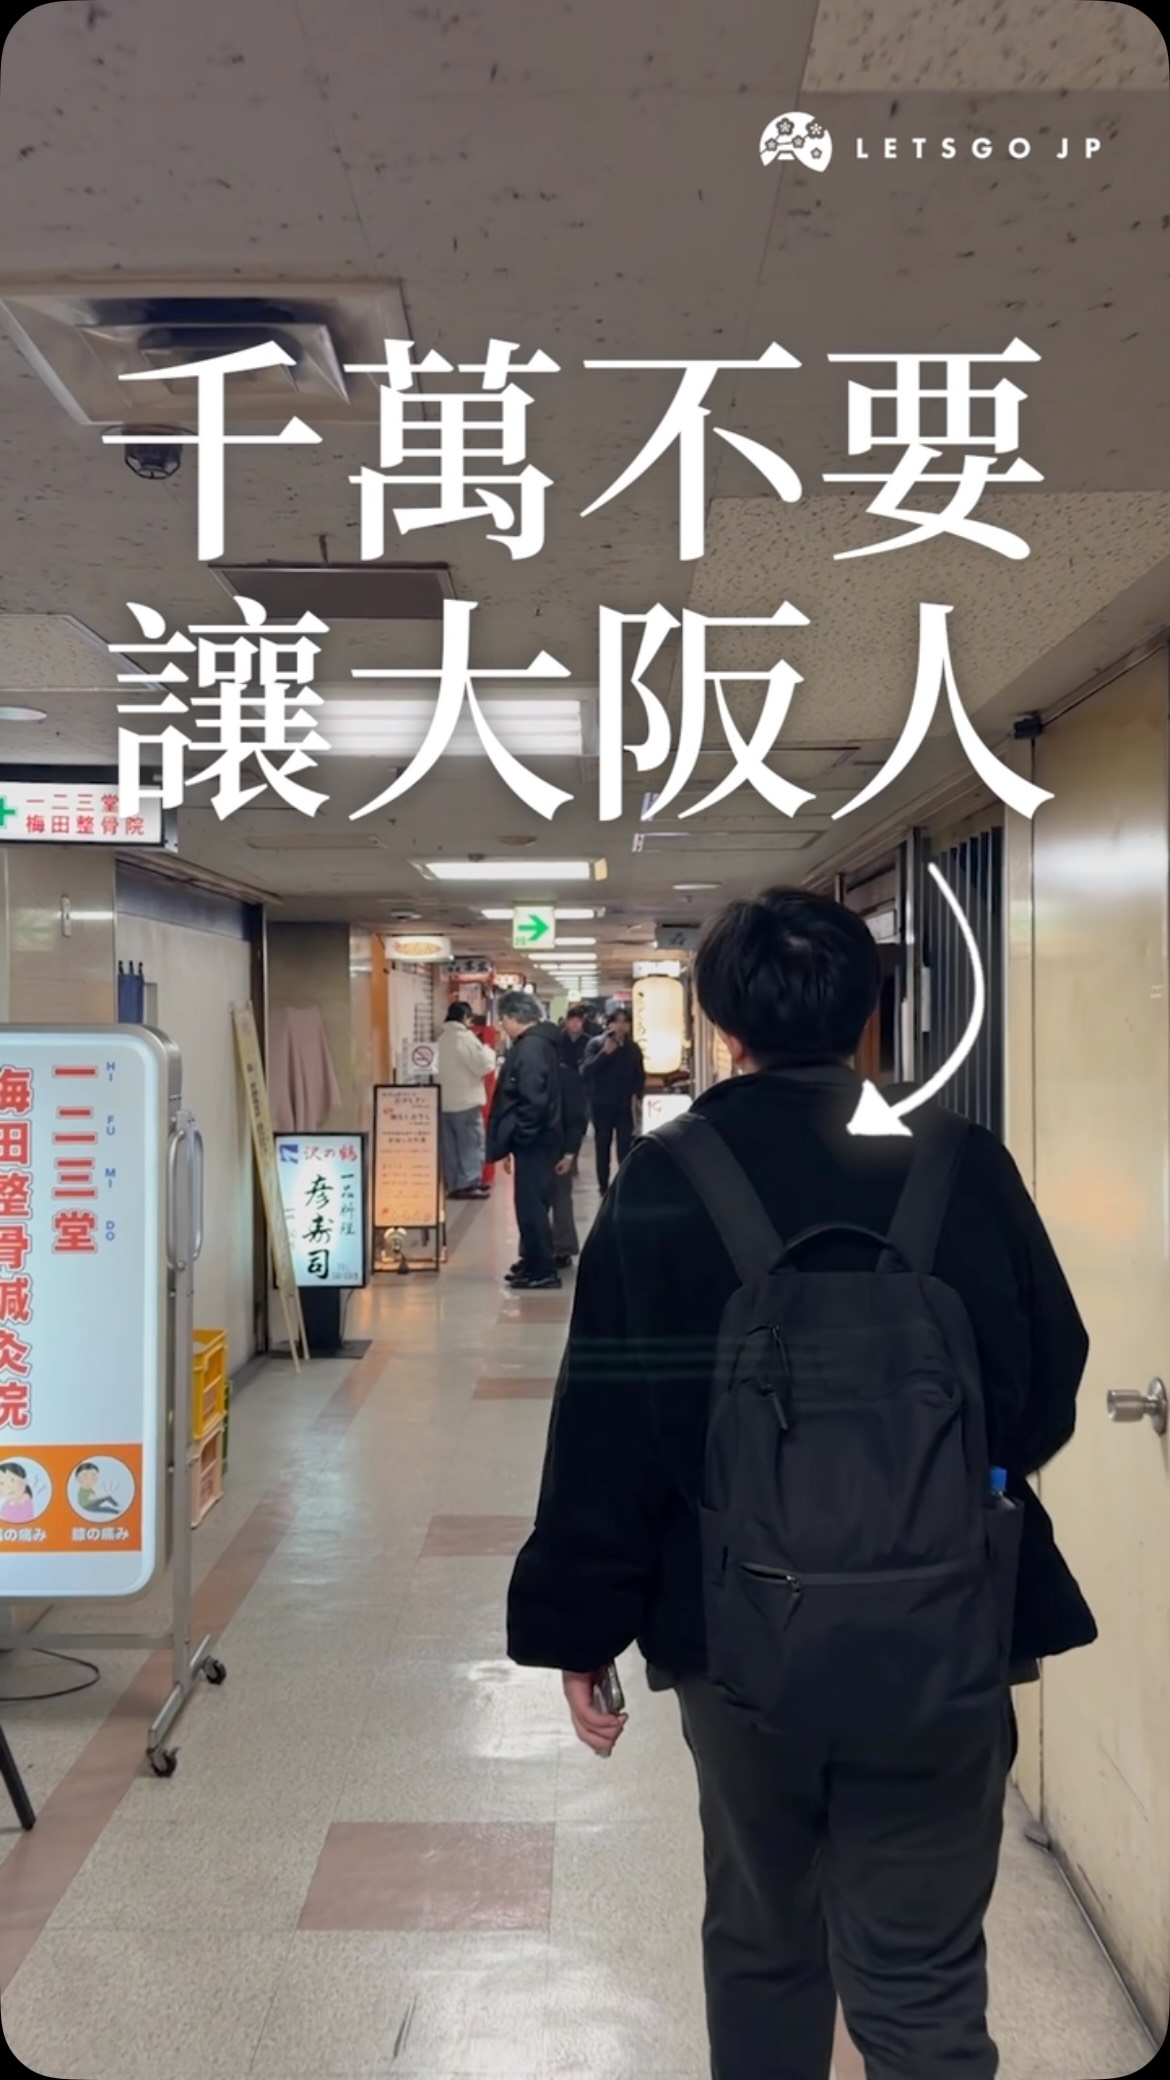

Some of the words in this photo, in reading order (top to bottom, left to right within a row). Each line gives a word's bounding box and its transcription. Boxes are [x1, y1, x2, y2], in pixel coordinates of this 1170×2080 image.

[26, 793, 119, 813] 一二三堂
[26, 815, 145, 836] 梅田整骨院
[52, 1065, 98, 1254] 一二三堂
[0, 1527, 47, 1542] の痛み
